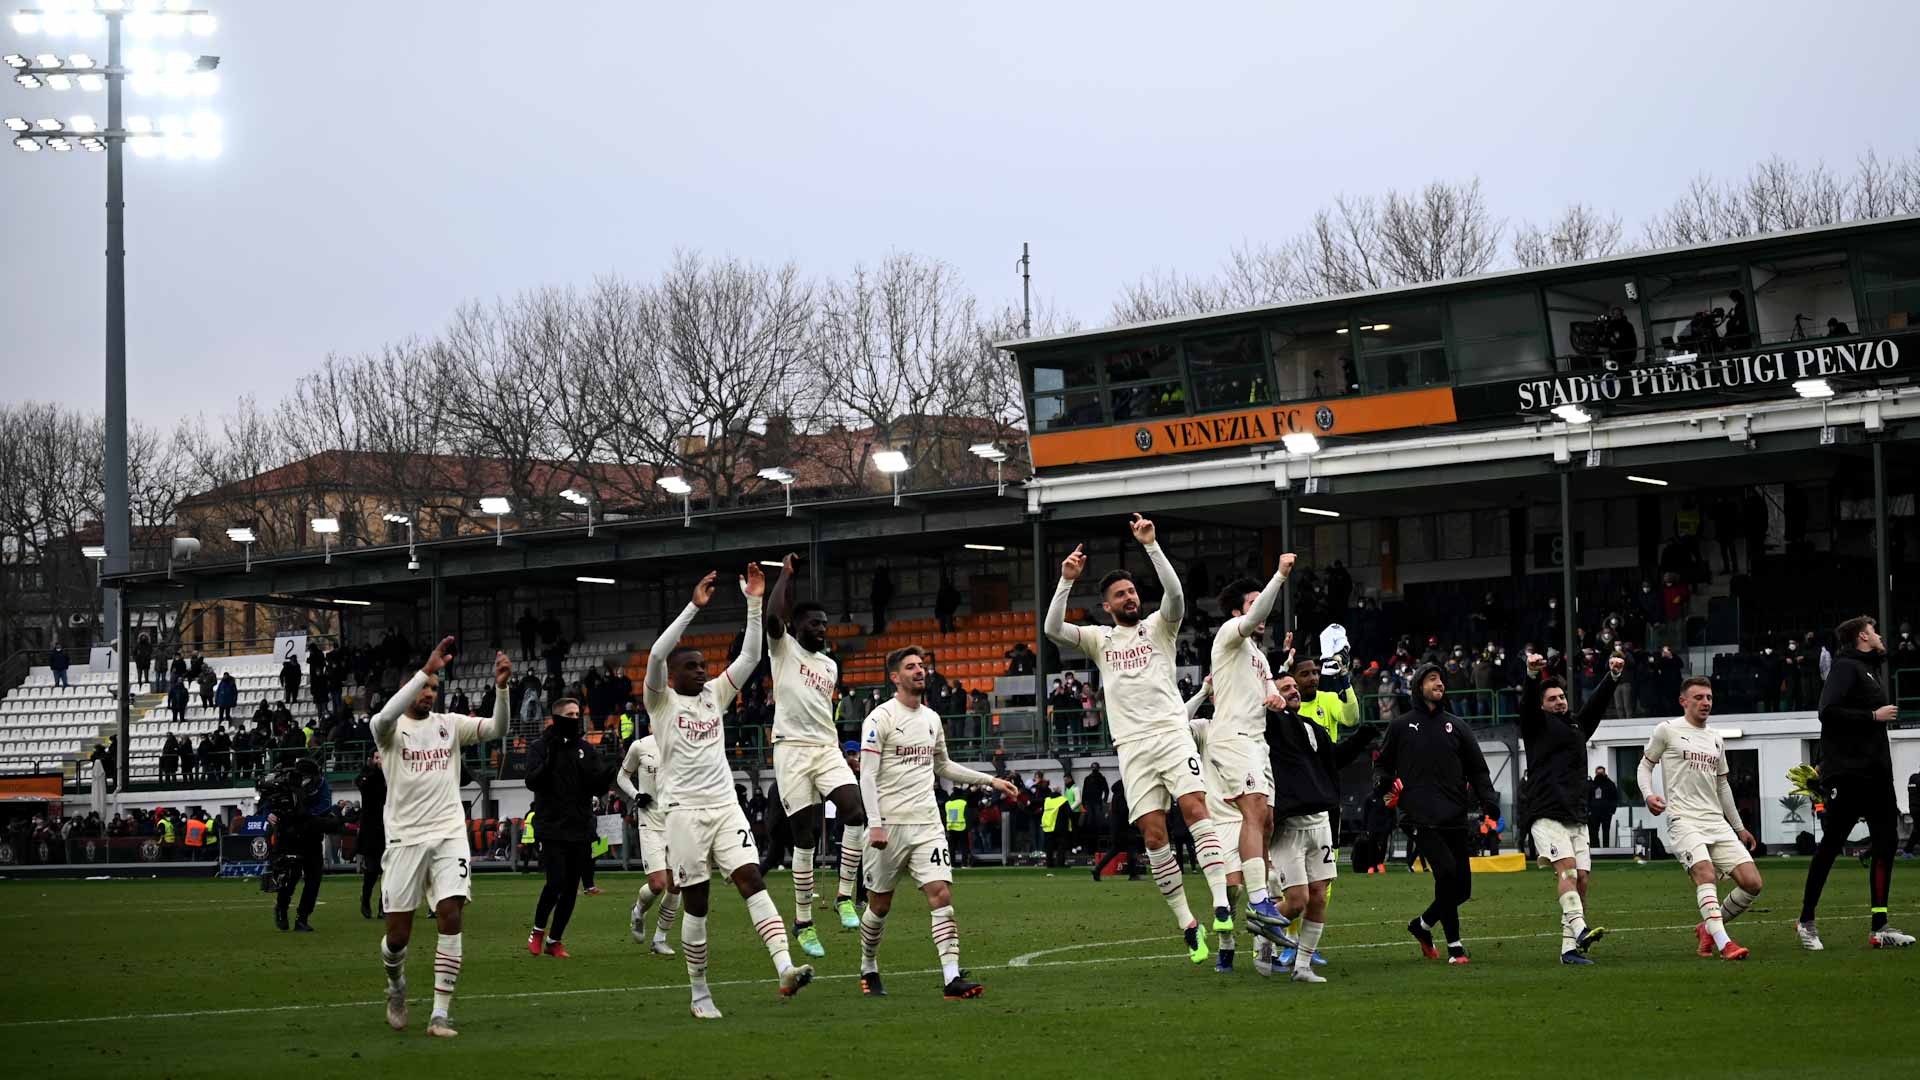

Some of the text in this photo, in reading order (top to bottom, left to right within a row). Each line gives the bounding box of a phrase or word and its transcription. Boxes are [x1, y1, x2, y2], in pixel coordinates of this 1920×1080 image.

[1518, 339, 1899, 410] STADIO PIERLUIGI PENZO
[1164, 409, 1303, 448] VENEZIA FC
[285, 639, 295, 660] 2
[1105, 644, 1153, 662] Emirates
[105, 651, 112, 669] 1
[800, 664, 834, 689] Emirate
[402, 748, 451, 761] Emirate
[895, 745, 935, 757] Emirate
[1682, 750, 1719, 765] Emirate
[1188, 757, 1200, 776] 9
[247, 821, 262, 830] SERIE
[737, 828, 755, 848] 2
[930, 847, 951, 867] 46
[1321, 845, 1336, 864] 2
[458, 858, 471, 878] 3
